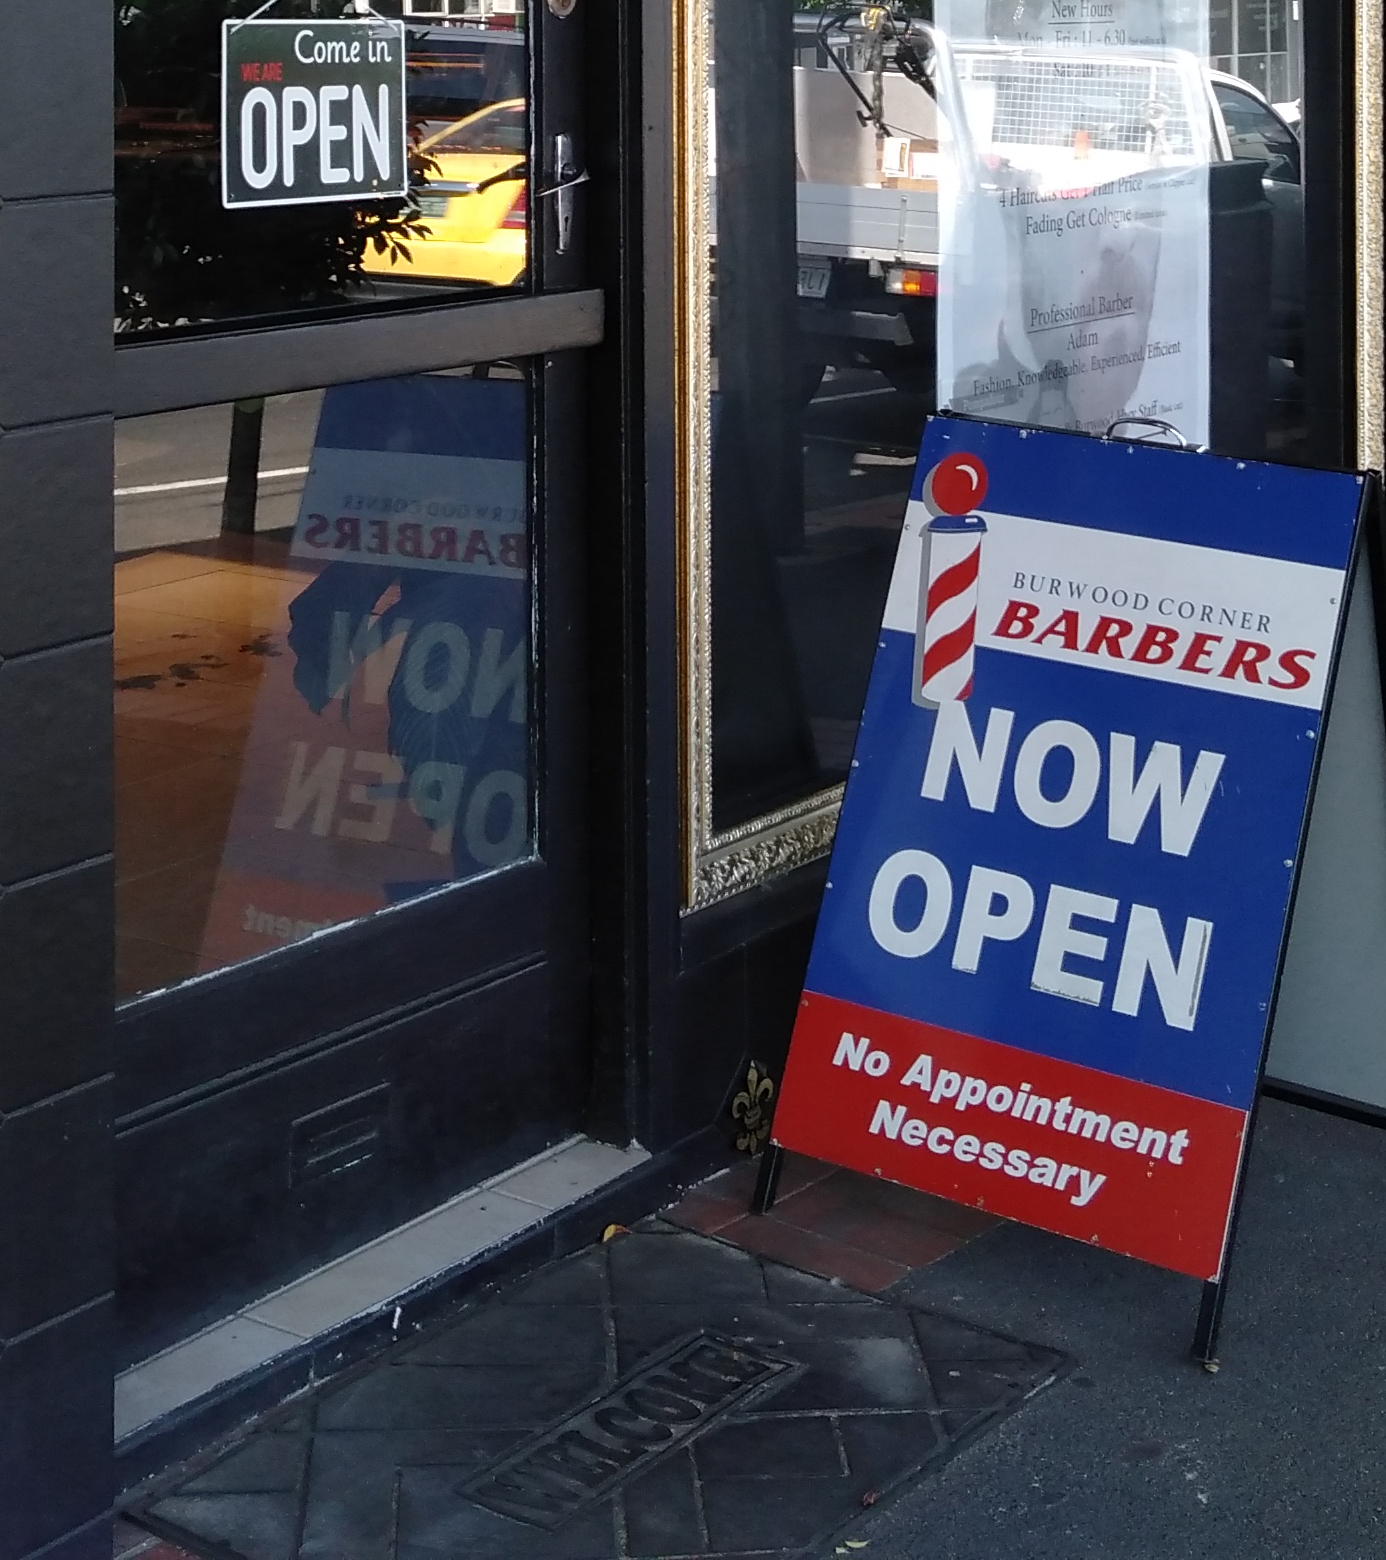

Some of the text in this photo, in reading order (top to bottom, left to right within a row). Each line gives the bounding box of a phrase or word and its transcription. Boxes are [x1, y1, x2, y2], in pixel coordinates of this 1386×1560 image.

[1051, 0, 1113, 19] New Hours
[294, 30, 393, 65] Come in
[241, 62, 283, 82] WE ARE
[240, 83, 391, 190] OPEN
[1118, 176, 1143, 195] Price
[1026, 214, 1063, 237] Fading
[1066, 210, 1086, 230] Get
[1088, 206, 1132, 230] Cologne
[1030, 292, 1134, 327] Professional Barber
[1067, 329, 1099, 351] Adam
[1147, 340, 1181, 360] Efficient
[1138, 399, 1158, 418] Staff
[1012, 570, 1273, 636] BURWOOD CORNER
[990, 599, 1318, 692] BARBERS
[920, 700, 1227, 858] NOW
[867, 848, 1215, 1033] OPEN
[831, 1029, 1190, 1169] No Appointment
[867, 1098, 1107, 1209] Necessary
